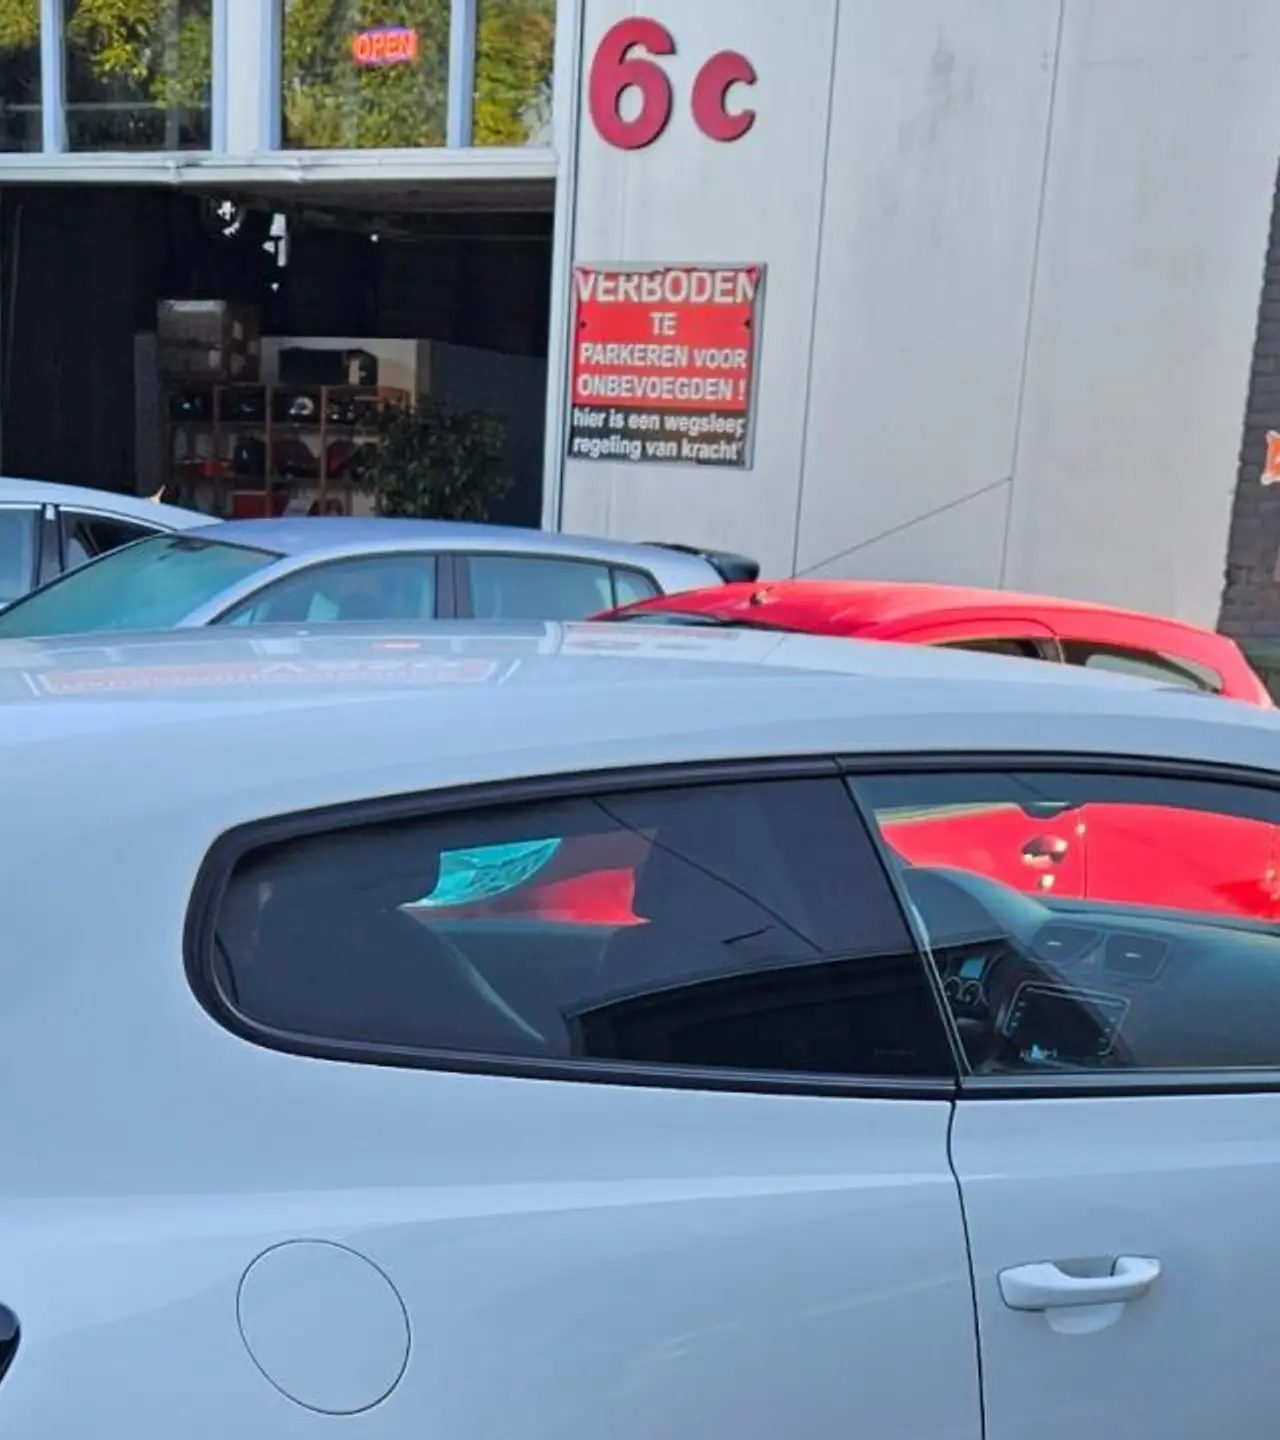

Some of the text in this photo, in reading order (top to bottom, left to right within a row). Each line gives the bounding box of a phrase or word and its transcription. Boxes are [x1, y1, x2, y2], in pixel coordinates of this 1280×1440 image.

[353, 30, 417, 60] OPEN
[573, 269, 757, 303] VERBODEN
[649, 311, 677, 336] TE
[579, 342, 748, 370] PARKEREN VOOR
[576, 373, 733, 400] ONBEVOEGDEN
[573, 407, 606, 429] hier
[608, 408, 625, 429] is
[627, 414, 660, 432] een
[572, 435, 642, 460] regeling
[645, 441, 680, 459] van
